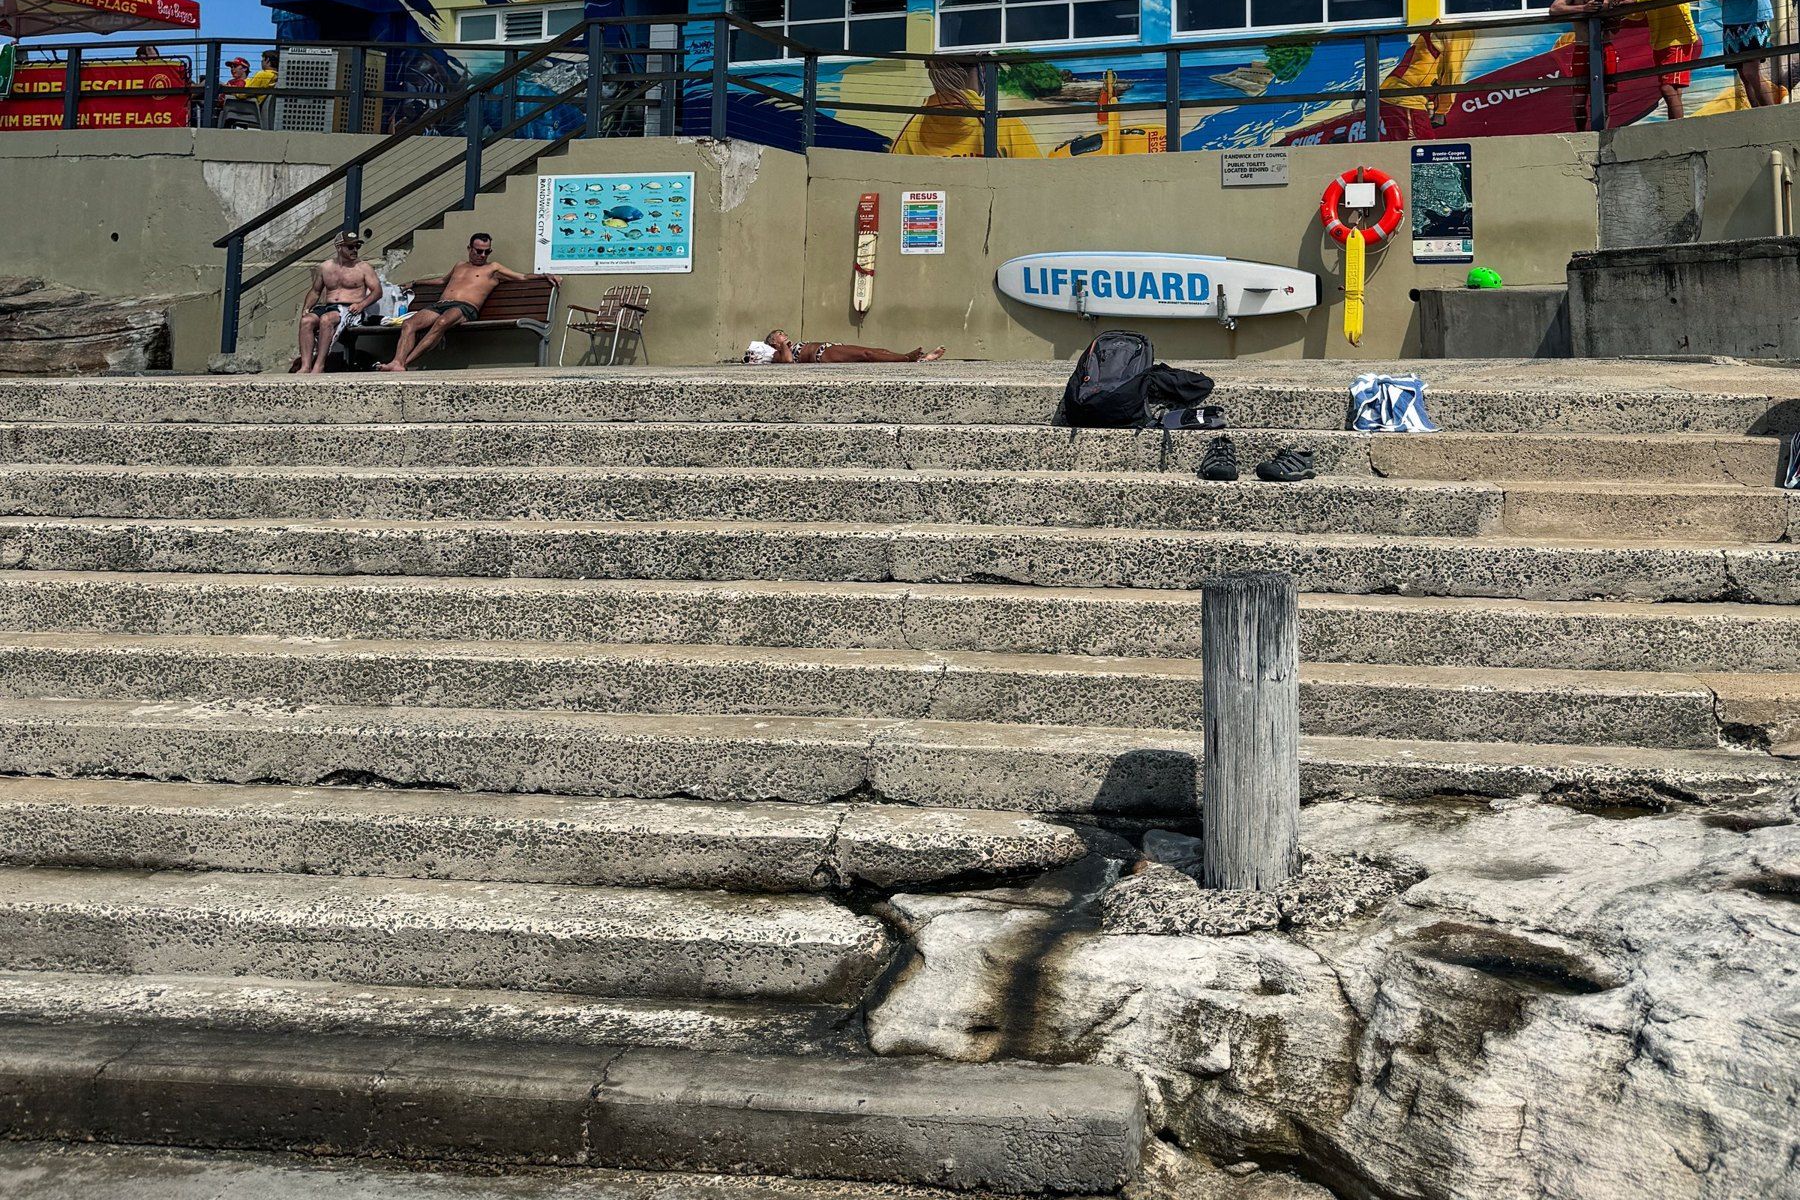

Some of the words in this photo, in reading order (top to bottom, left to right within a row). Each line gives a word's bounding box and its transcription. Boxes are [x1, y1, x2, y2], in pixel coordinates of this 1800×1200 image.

[80, 79, 144, 91] ESCUE
[23, 113, 89, 127] BETWN
[93, 112, 121, 125] THE
[125, 112, 172, 125] FLAGS
[909, 192, 938, 200] RESUS
[1023, 267, 1210, 302] LIFEGUARD
